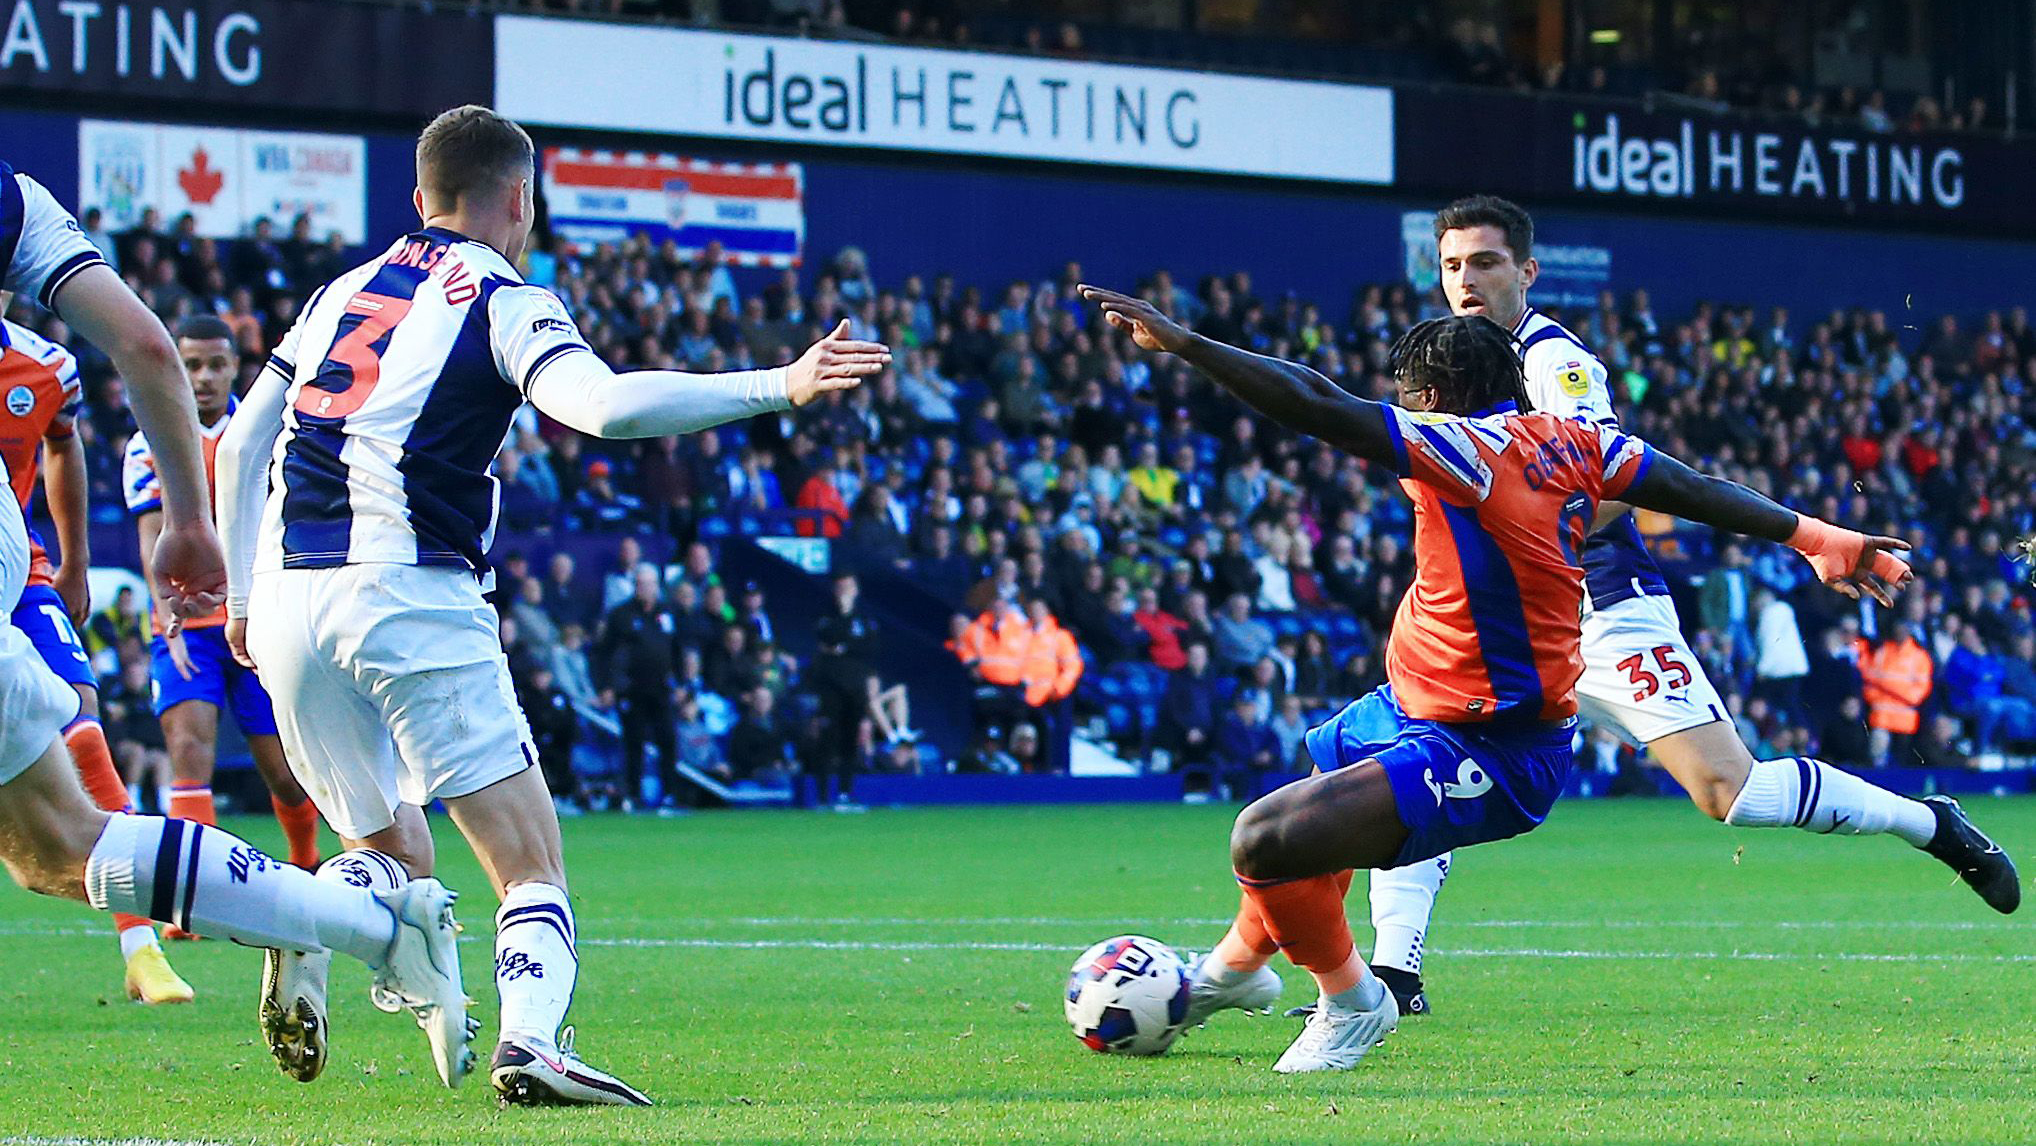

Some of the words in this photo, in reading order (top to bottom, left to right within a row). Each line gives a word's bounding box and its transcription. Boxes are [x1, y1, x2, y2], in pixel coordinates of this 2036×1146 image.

[0, 0, 262, 86] ATING
[723, 43, 867, 132] ideal
[891, 65, 1200, 149] HEATING
[1573, 111, 1696, 199] ideal
[1708, 130, 1965, 208] HEATING
[293, 291, 414, 418] 3
[1615, 645, 1692, 702] 35
[1443, 757, 1494, 799] 9
